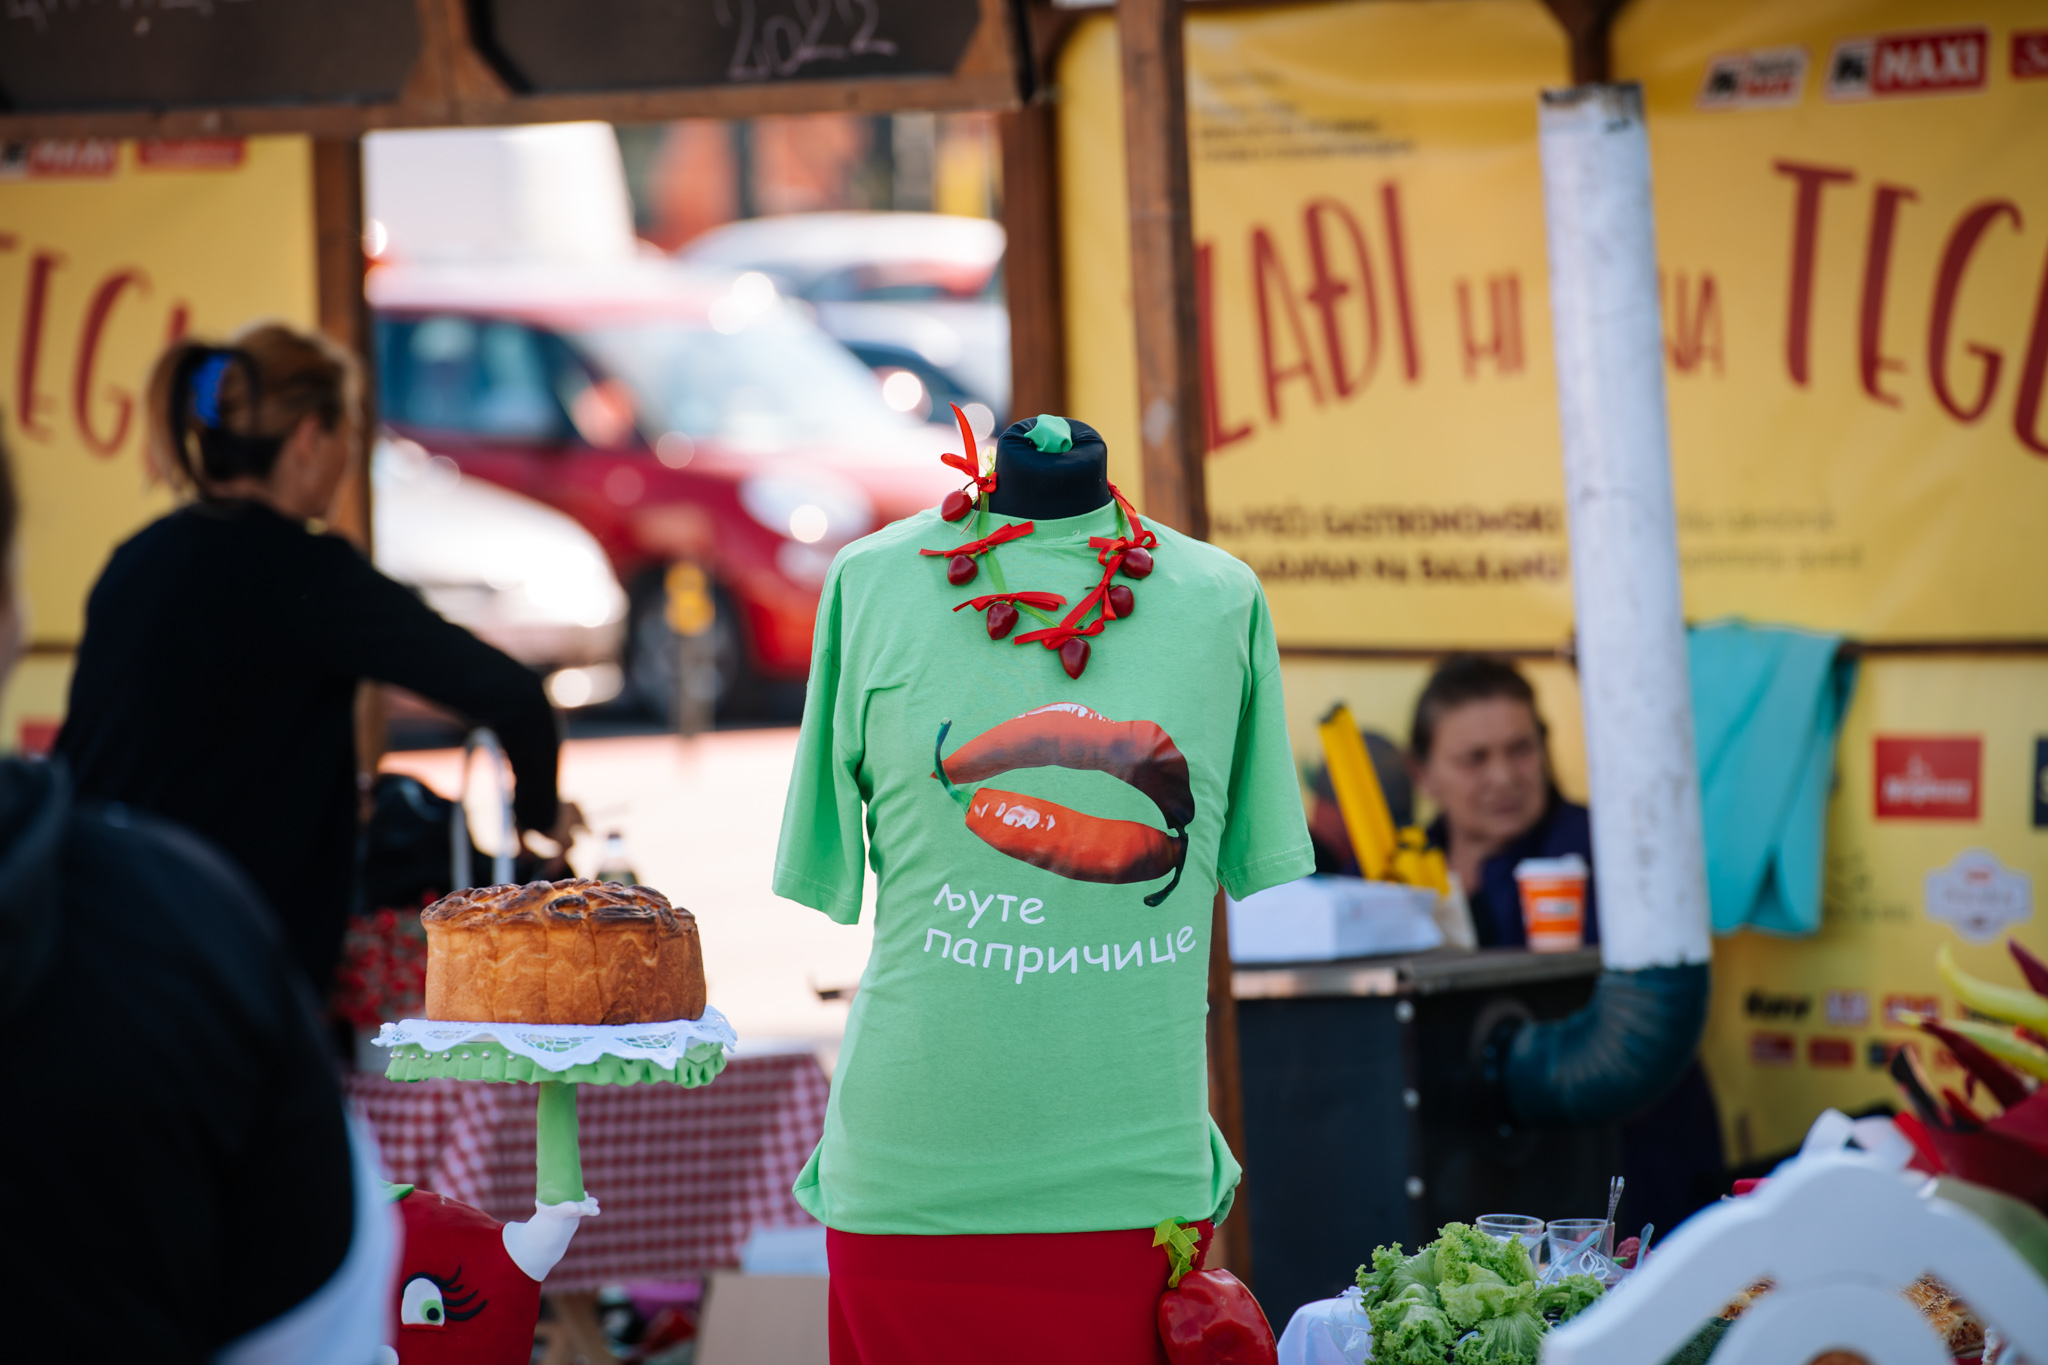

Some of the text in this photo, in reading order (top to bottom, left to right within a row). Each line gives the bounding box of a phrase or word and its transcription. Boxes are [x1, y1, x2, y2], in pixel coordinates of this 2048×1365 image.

[1876, 38, 1981, 86] MAXI
[1195, 182, 1419, 453] LAĐI
[933, 882, 1045, 929] љуте
[923, 925, 1197, 985] папричице
